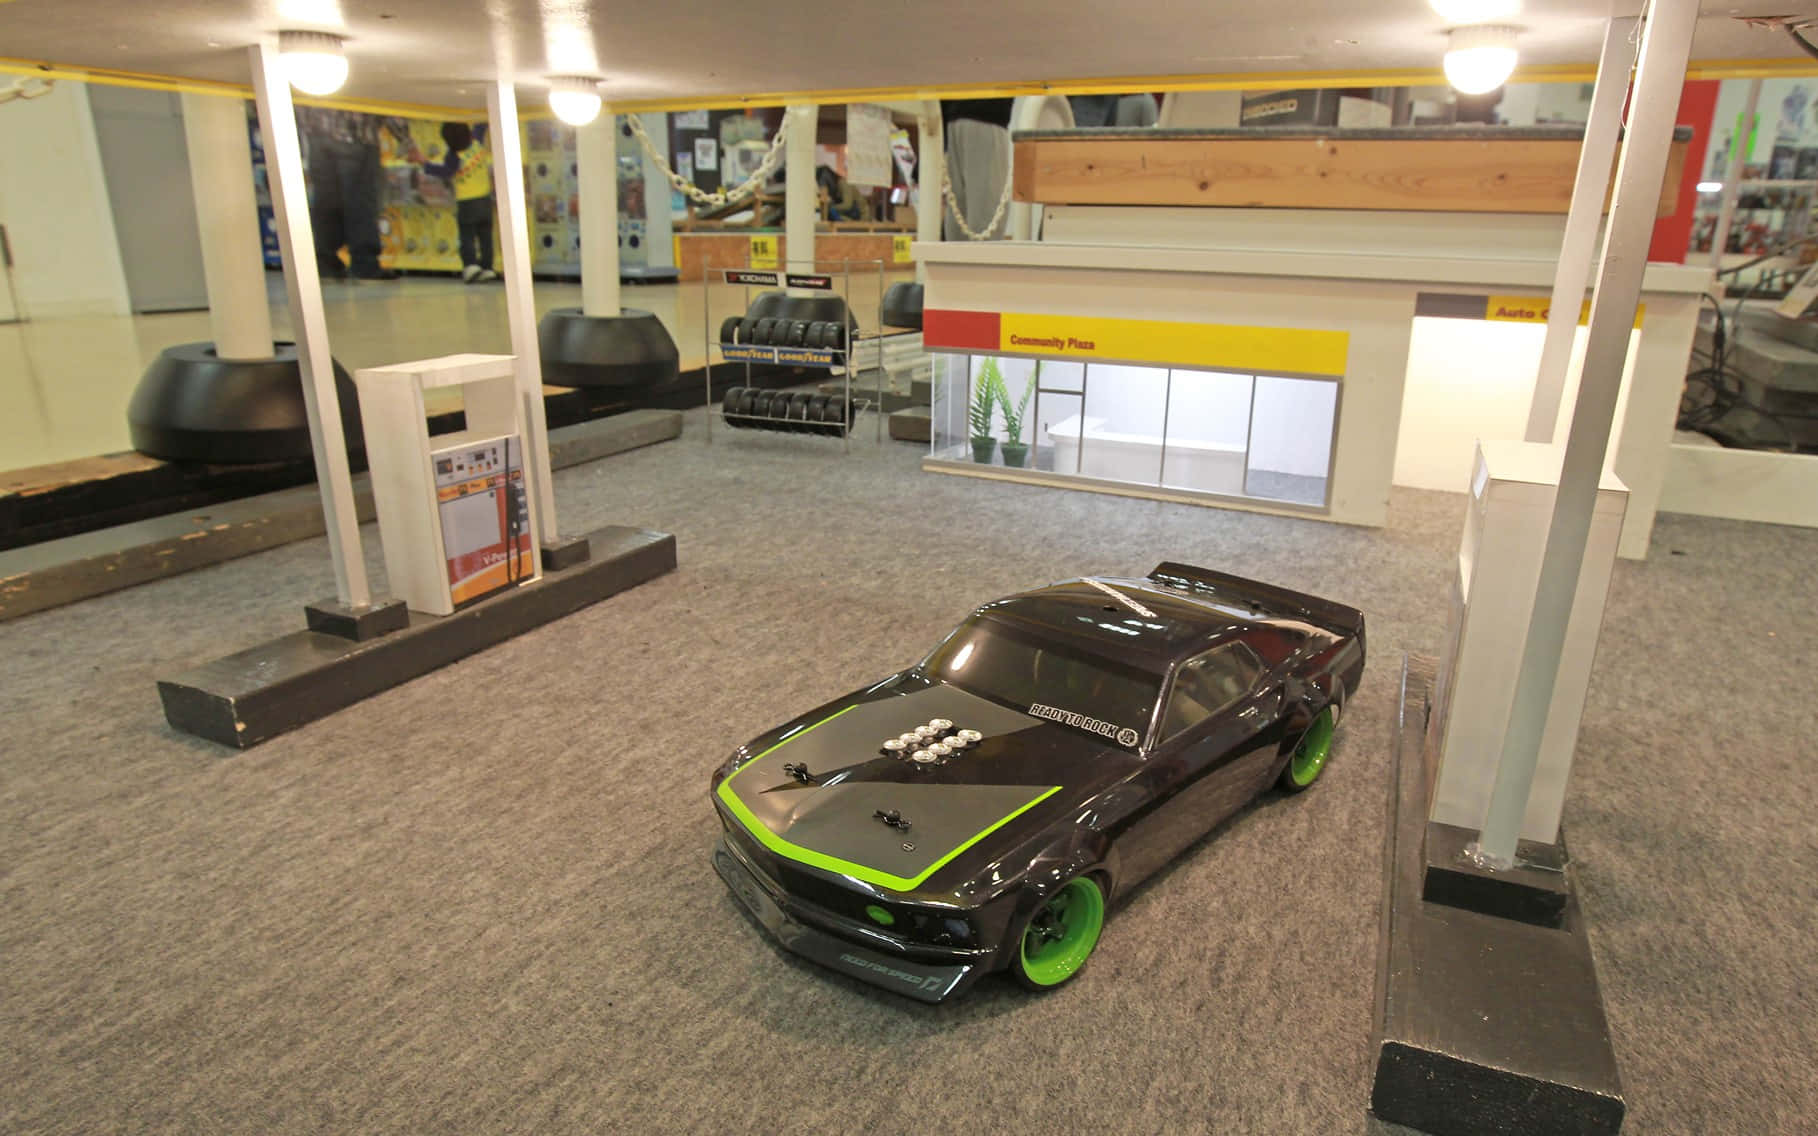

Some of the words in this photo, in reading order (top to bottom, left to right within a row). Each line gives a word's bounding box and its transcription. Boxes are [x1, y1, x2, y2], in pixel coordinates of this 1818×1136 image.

[1496, 307, 1535, 318] Auto
[1010, 334, 1065, 351] Community
[1068, 337, 1095, 350] Plaza
[780, 351, 832, 363] GOODYEAR
[1029, 703, 1068, 722] READY
[1066, 714, 1083, 727] TO
[1082, 717, 1118, 738] ROCK
